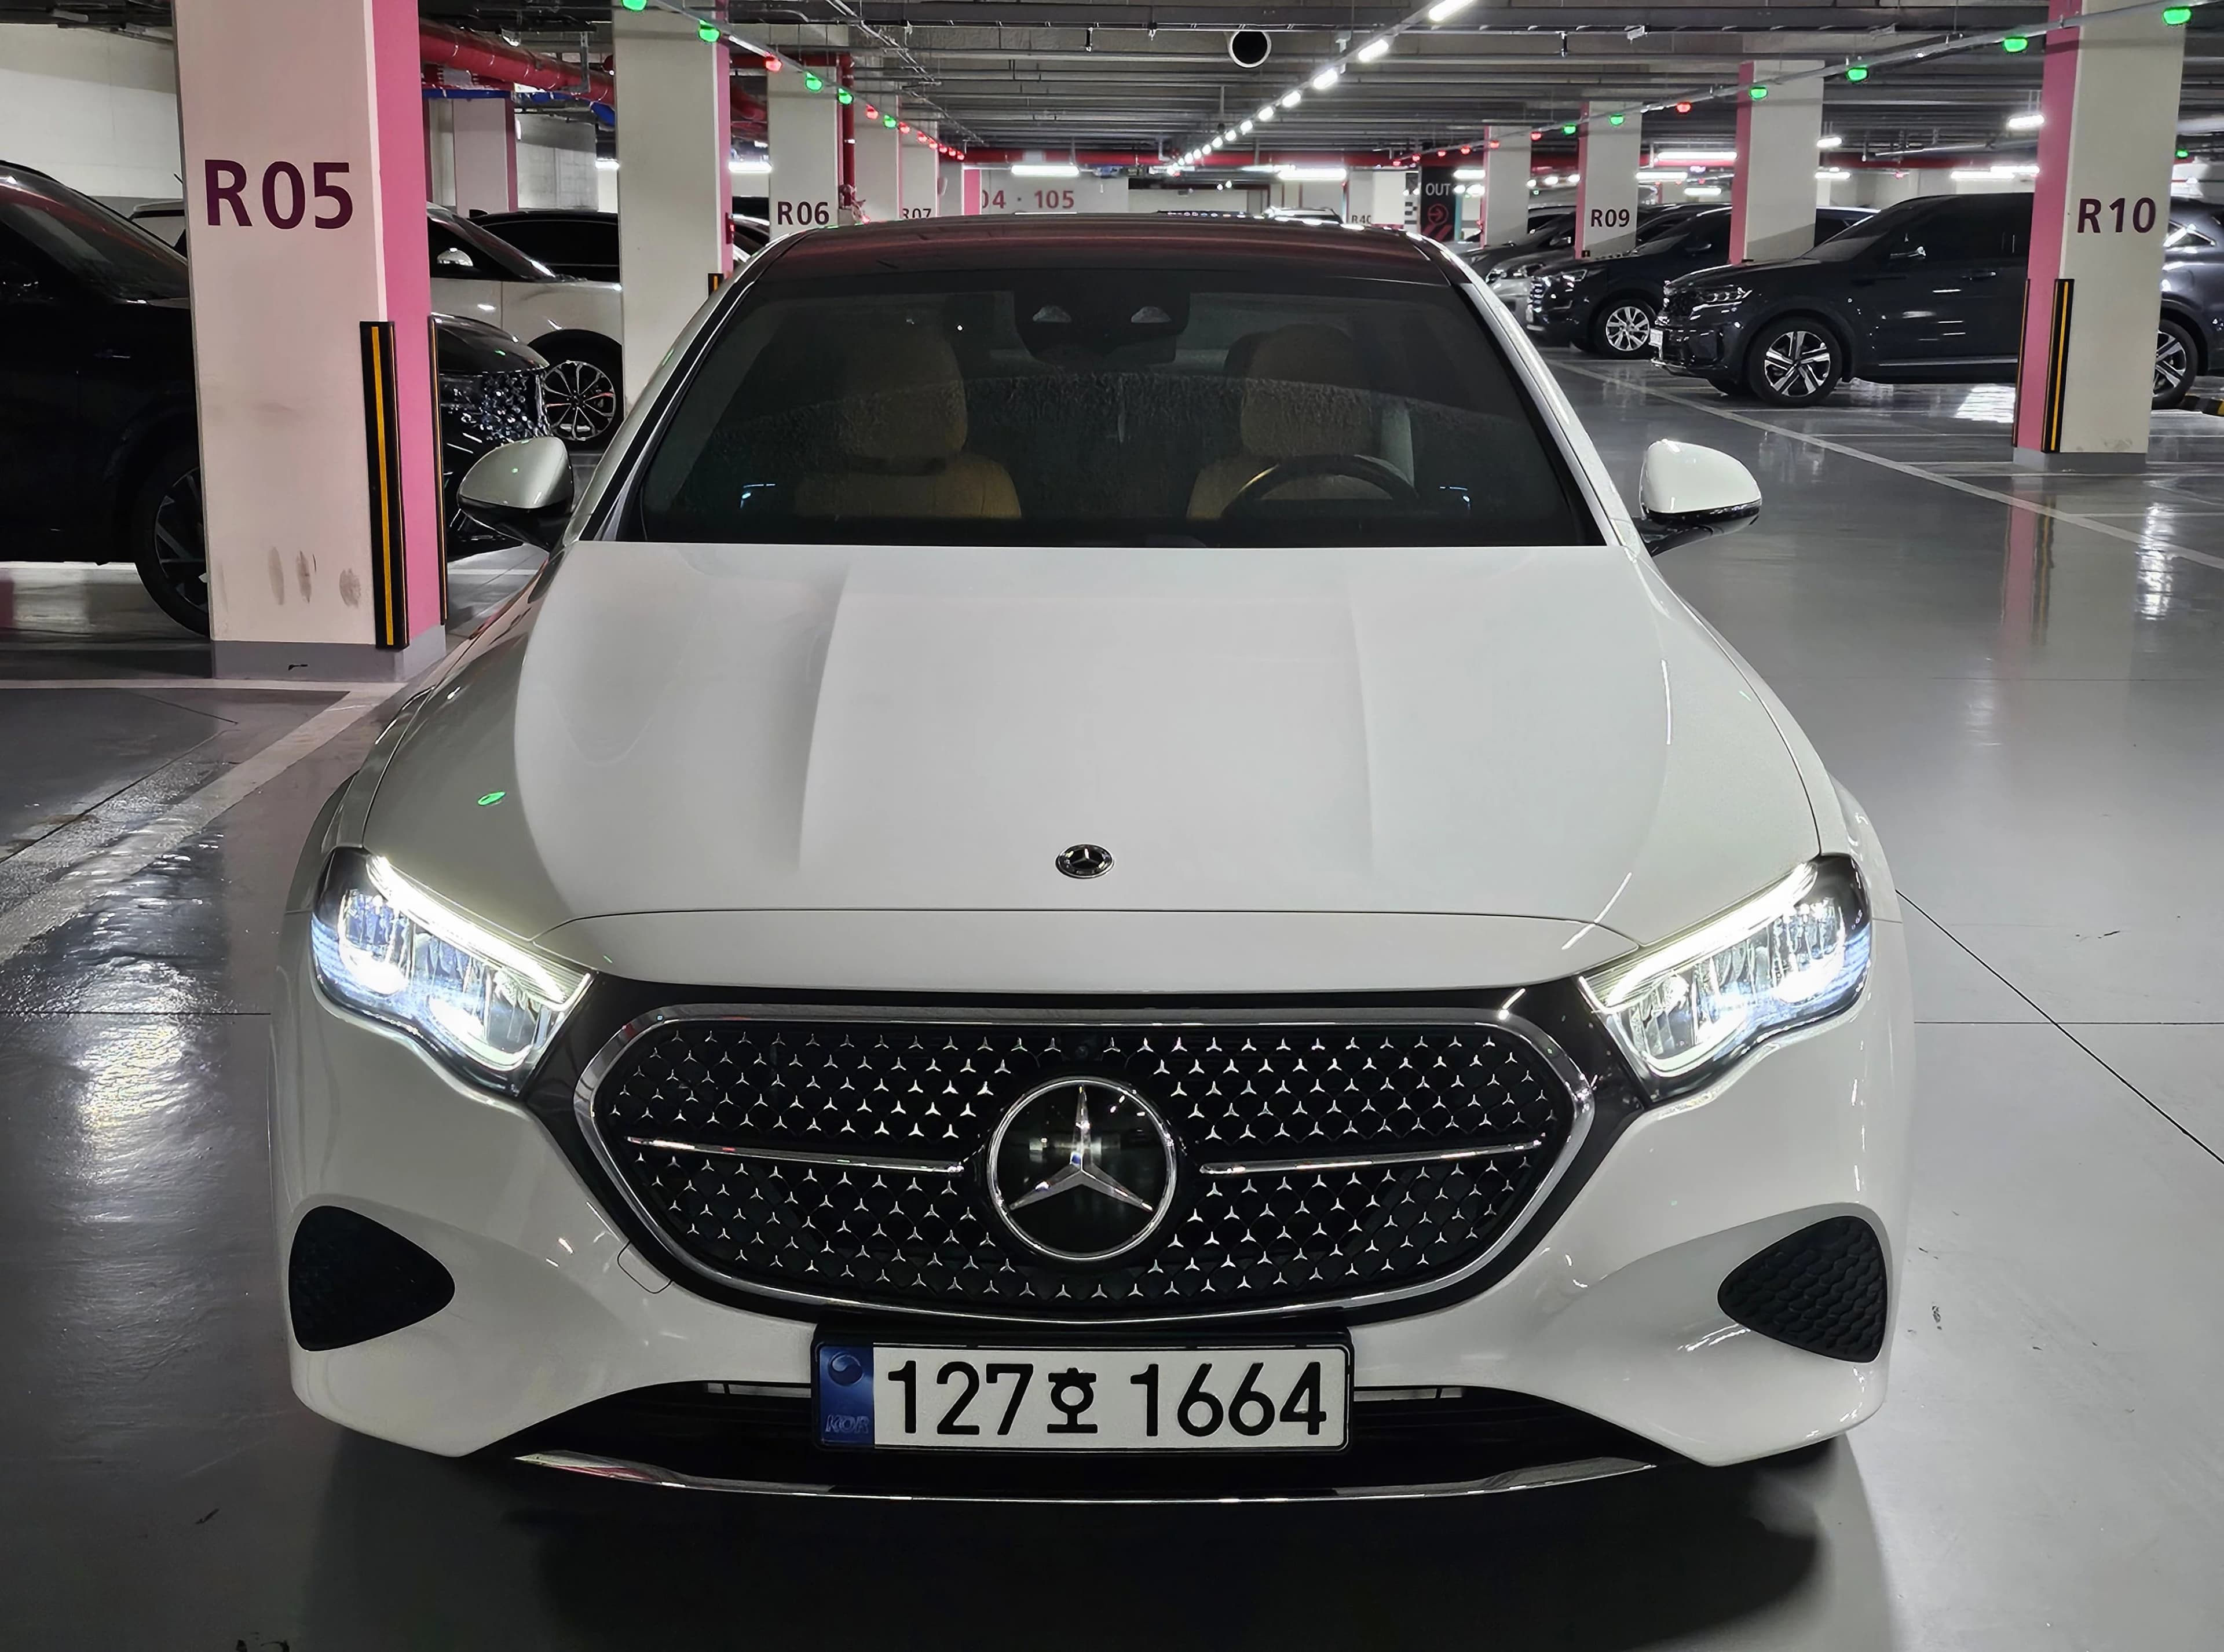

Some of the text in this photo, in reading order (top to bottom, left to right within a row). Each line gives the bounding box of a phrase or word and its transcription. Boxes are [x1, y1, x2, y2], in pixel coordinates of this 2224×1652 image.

[204, 159, 353, 229] R05
[1425, 183, 1451, 196] OUT
[1034, 190, 1074, 209] 105
[778, 202, 829, 225] R06
[903, 208, 931, 219] R07
[1591, 209, 1630, 227] R09
[2077, 198, 2156, 233] R10
[888, 1360, 1327, 1437] 127호 1664
[825, 1415, 869, 1434] KOR
